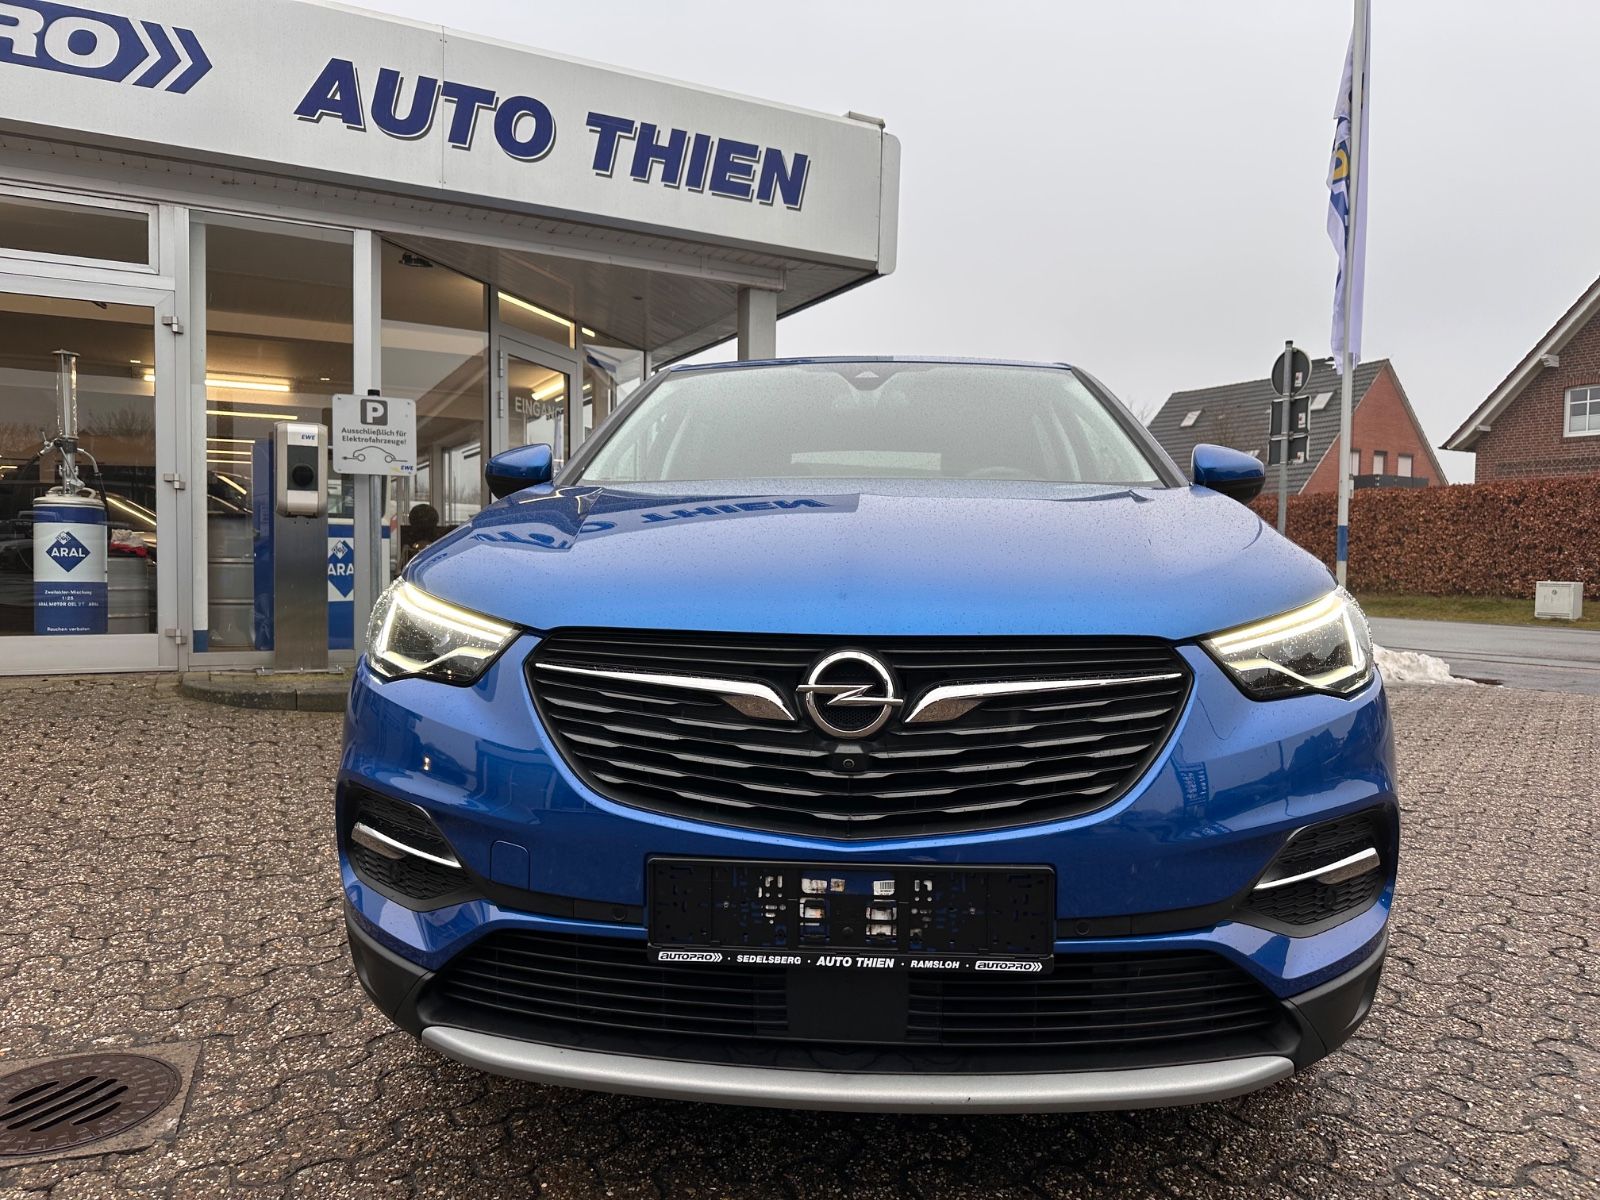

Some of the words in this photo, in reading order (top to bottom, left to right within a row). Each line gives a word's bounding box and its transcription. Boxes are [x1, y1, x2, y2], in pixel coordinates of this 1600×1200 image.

[293, 57, 556, 163] AUTO
[586, 111, 811, 212] THIEN
[366, 402, 385, 424] P
[341, 427, 395, 437] Ausschließlich
[342, 435, 407, 446] Elektrofahrzeuge!
[51, 547, 86, 557] ARAL
[736, 954, 802, 965] SEDELSBERG
[816, 956, 852, 967] AUTO
[856, 957, 895, 968] THIEN
[910, 960, 960, 969] RAMSLOH
